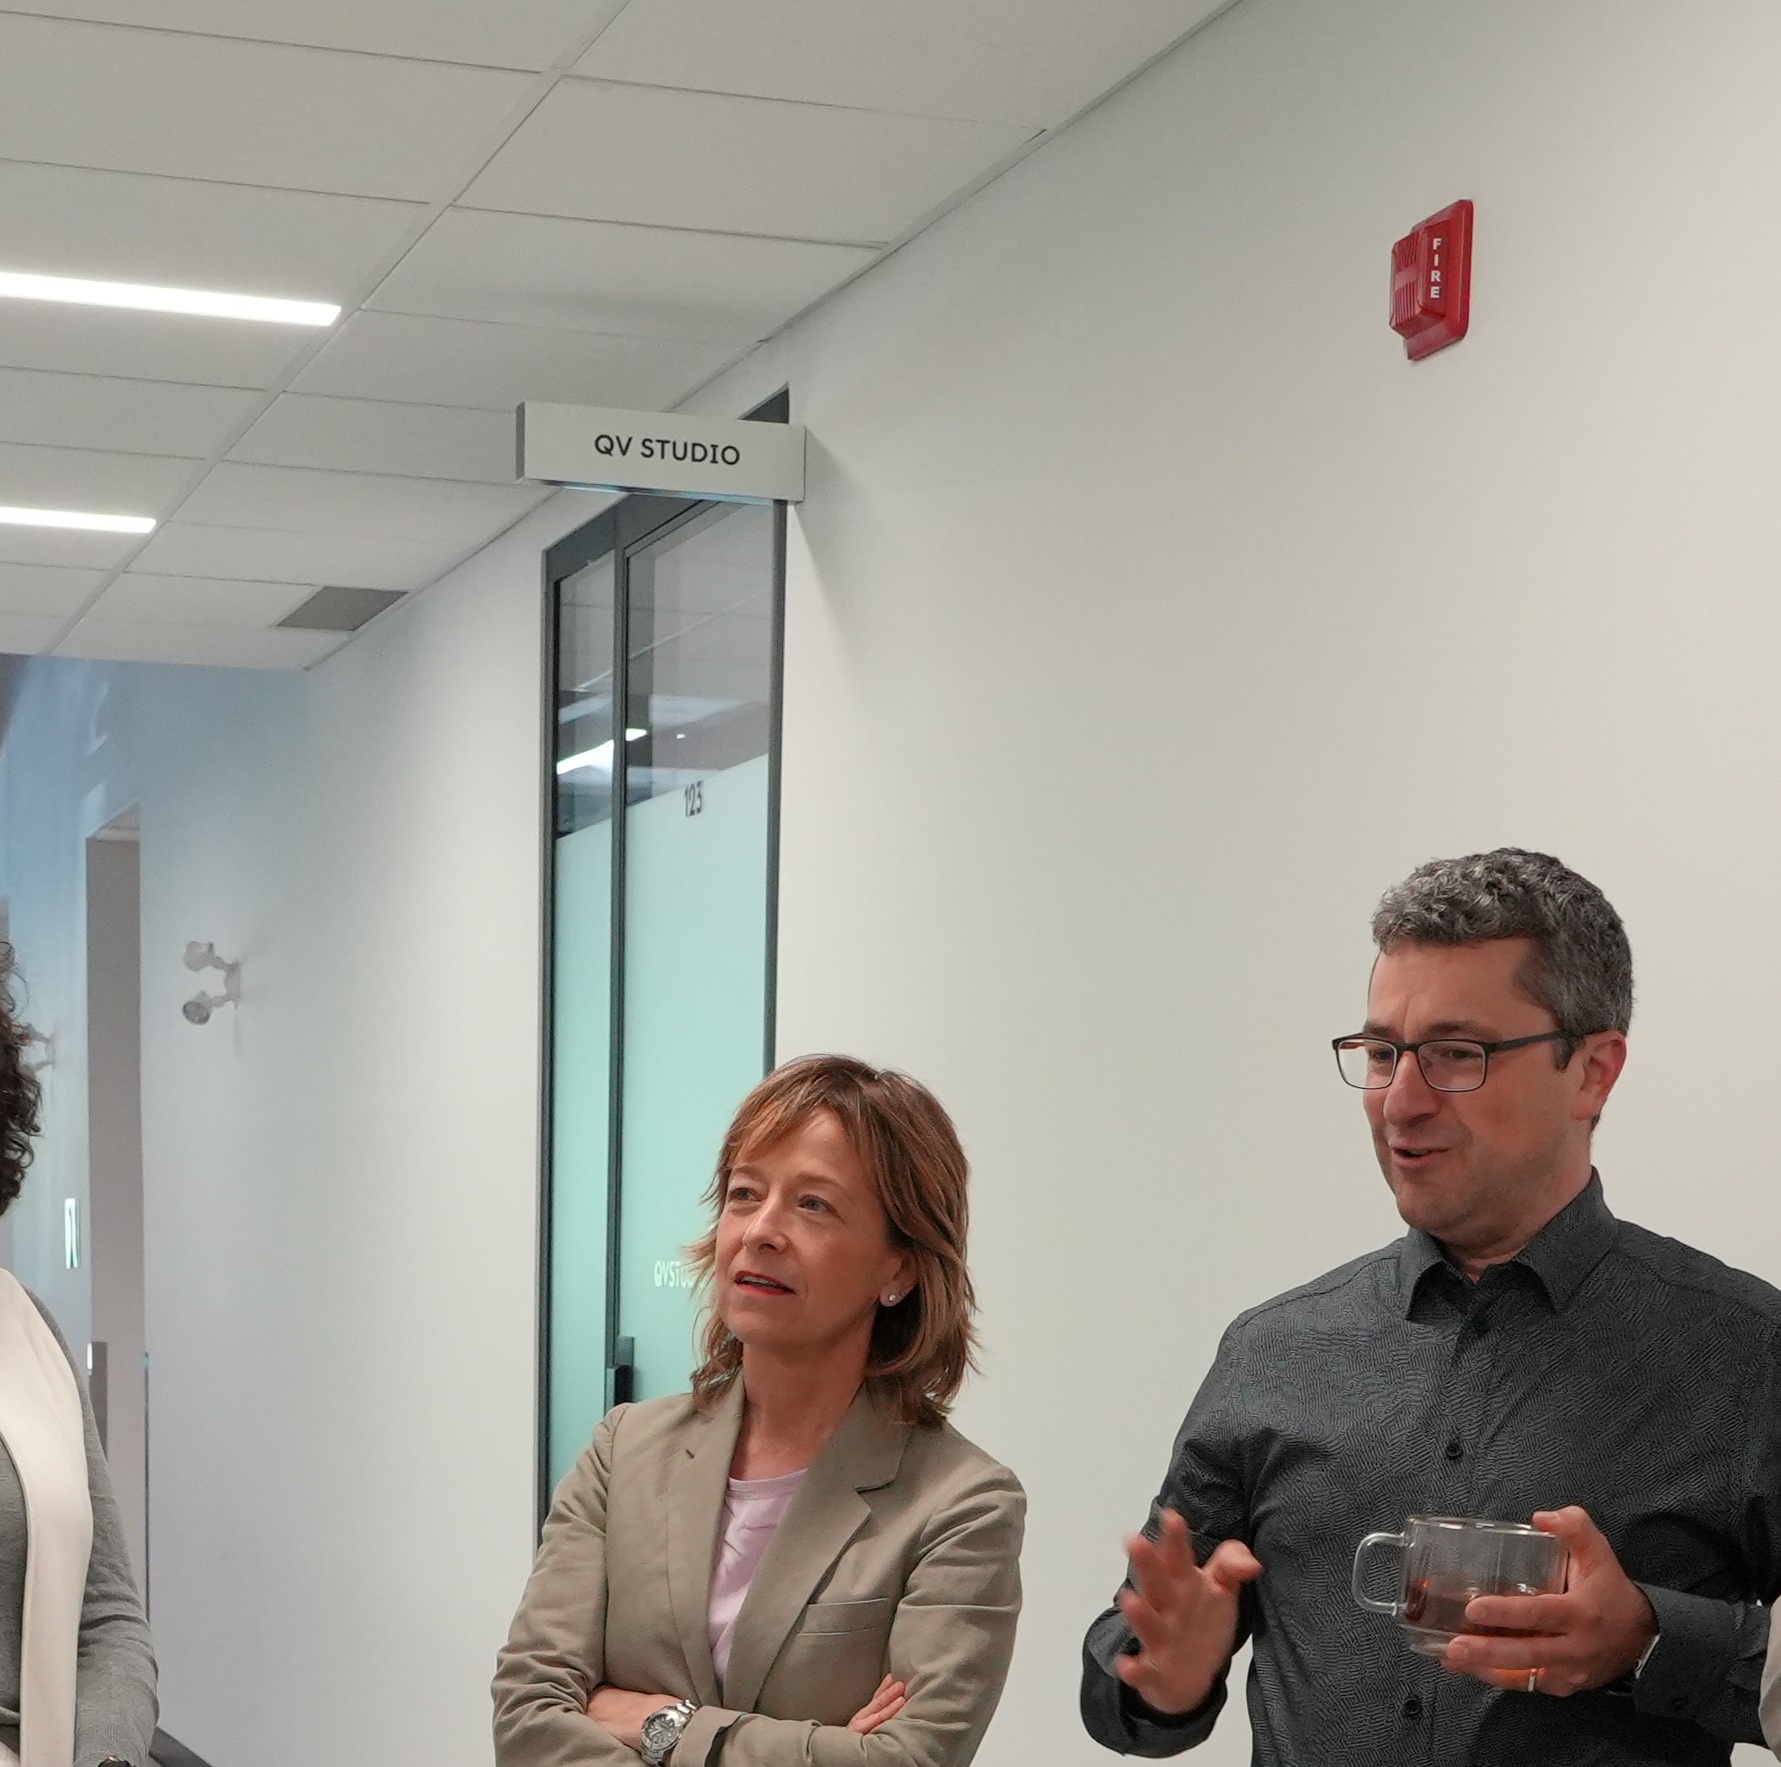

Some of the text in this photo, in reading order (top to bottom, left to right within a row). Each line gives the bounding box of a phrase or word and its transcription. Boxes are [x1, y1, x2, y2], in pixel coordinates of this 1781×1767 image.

[1430, 237, 1442, 299] FIRE
[594, 434, 740, 466] QV STUDIO
[684, 780, 703, 818] 123
[654, 1260, 695, 1288] QVSTU
